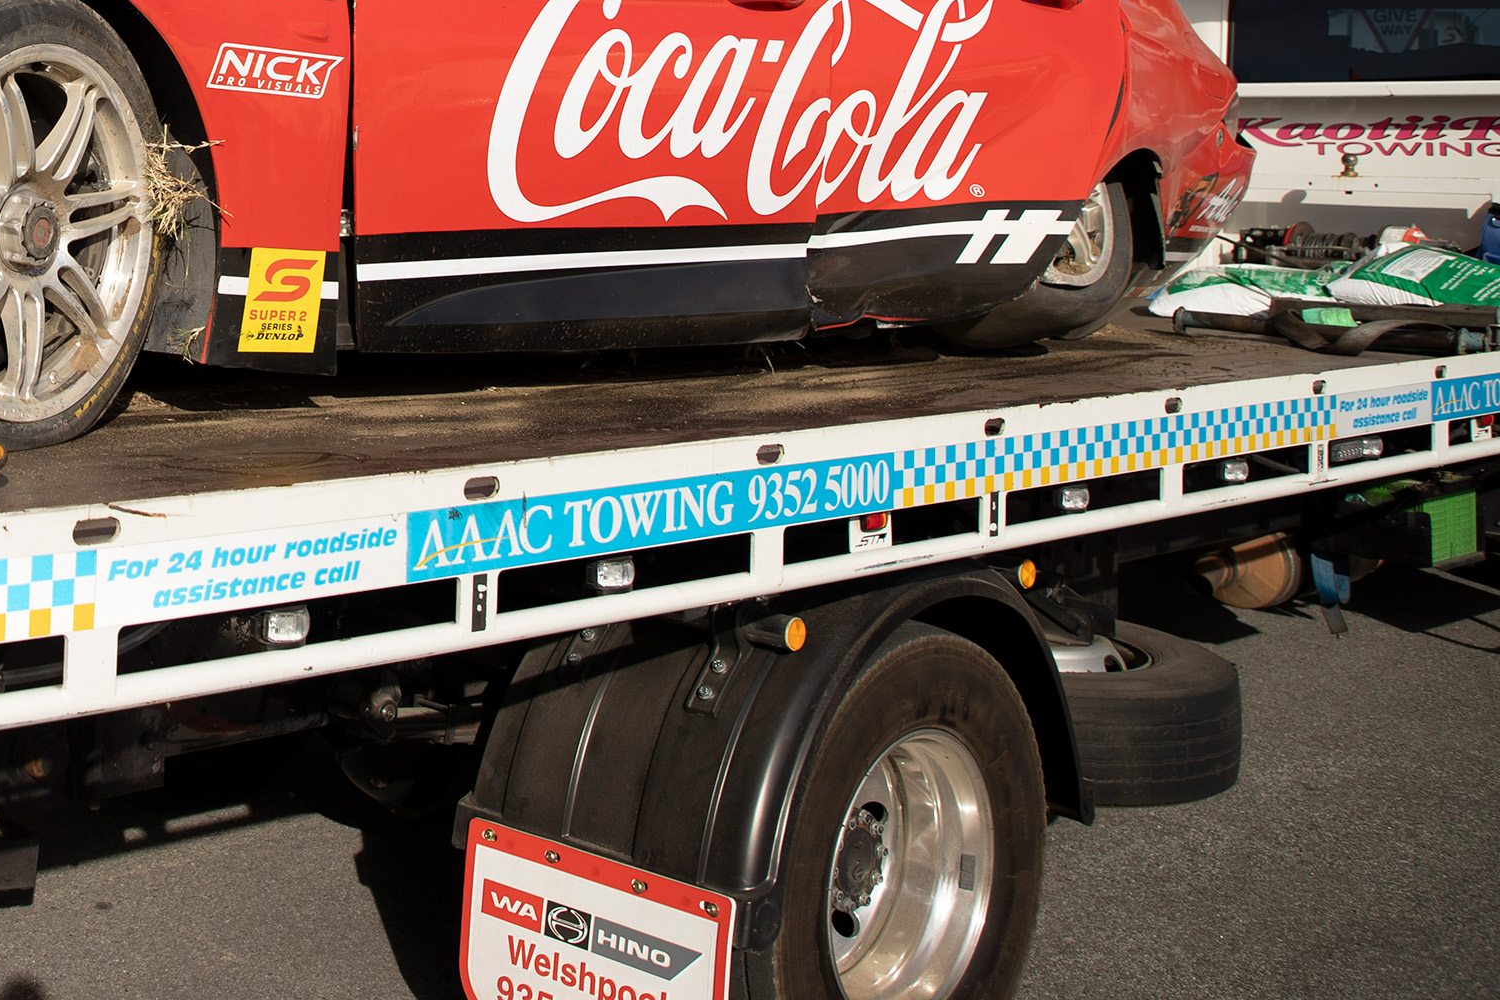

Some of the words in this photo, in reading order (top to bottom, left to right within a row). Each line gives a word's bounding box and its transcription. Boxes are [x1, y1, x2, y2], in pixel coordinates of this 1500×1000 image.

[1373, 8, 1417, 24] GIVE
[1379, 25, 1414, 37] WAY
[218, 49, 328, 85] NICK
[215, 76, 247, 87] PRO
[257, 79, 322, 95] VISUALS
[249, 309, 297, 321] SUPER
[299, 311, 307, 322] 2
[261, 322, 293, 331] SERIES
[255, 332, 304, 341] DUNLOP
[1340, 400, 1355, 413] For
[1357, 397, 1368, 411] 24
[1369, 395, 1391, 409] hour
[1392, 388, 1429, 405] roadside
[1433, 381, 1481, 415] AAAC
[1353, 412, 1400, 429] assistance
[1403, 407, 1418, 422] call
[413, 504, 554, 572] AAAC
[563, 479, 736, 547] TOWING
[747, 467, 818, 524] 9352
[824, 459, 890, 512] 5000
[107, 556, 160, 581] For
[167, 549, 202, 575] 24
[211, 542, 277, 569] hour
[284, 526, 398, 560] roadside
[153, 570, 307, 609] assistance
[313, 560, 361, 587] call
[490, 891, 538, 922] WA
[597, 929, 672, 968] HINO
[508, 934, 667, 1000] Welshpo
